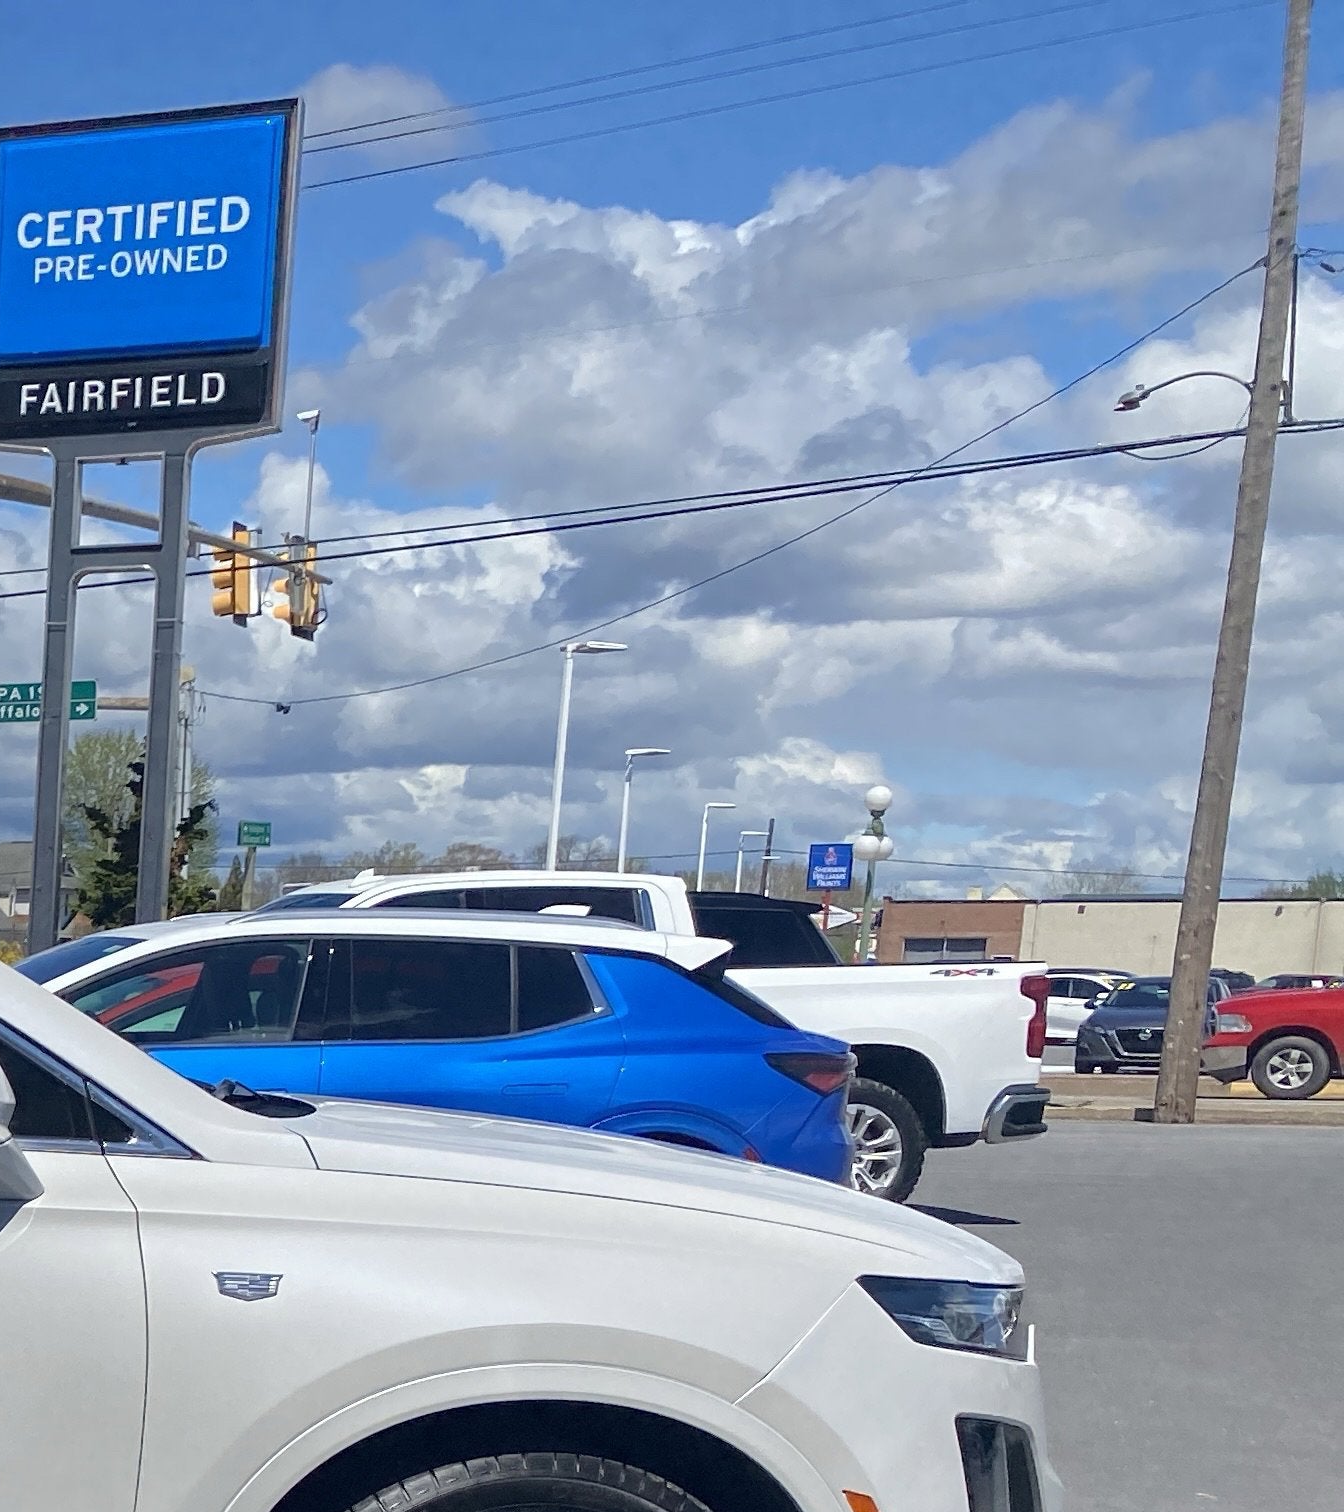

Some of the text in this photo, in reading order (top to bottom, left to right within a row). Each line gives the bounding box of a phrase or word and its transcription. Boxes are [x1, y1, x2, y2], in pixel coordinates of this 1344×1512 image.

[16, 195, 251, 249] CERTIFIED
[33, 243, 229, 284] PRE-OWNED
[19, 371, 227, 416] FAIRFIELD
